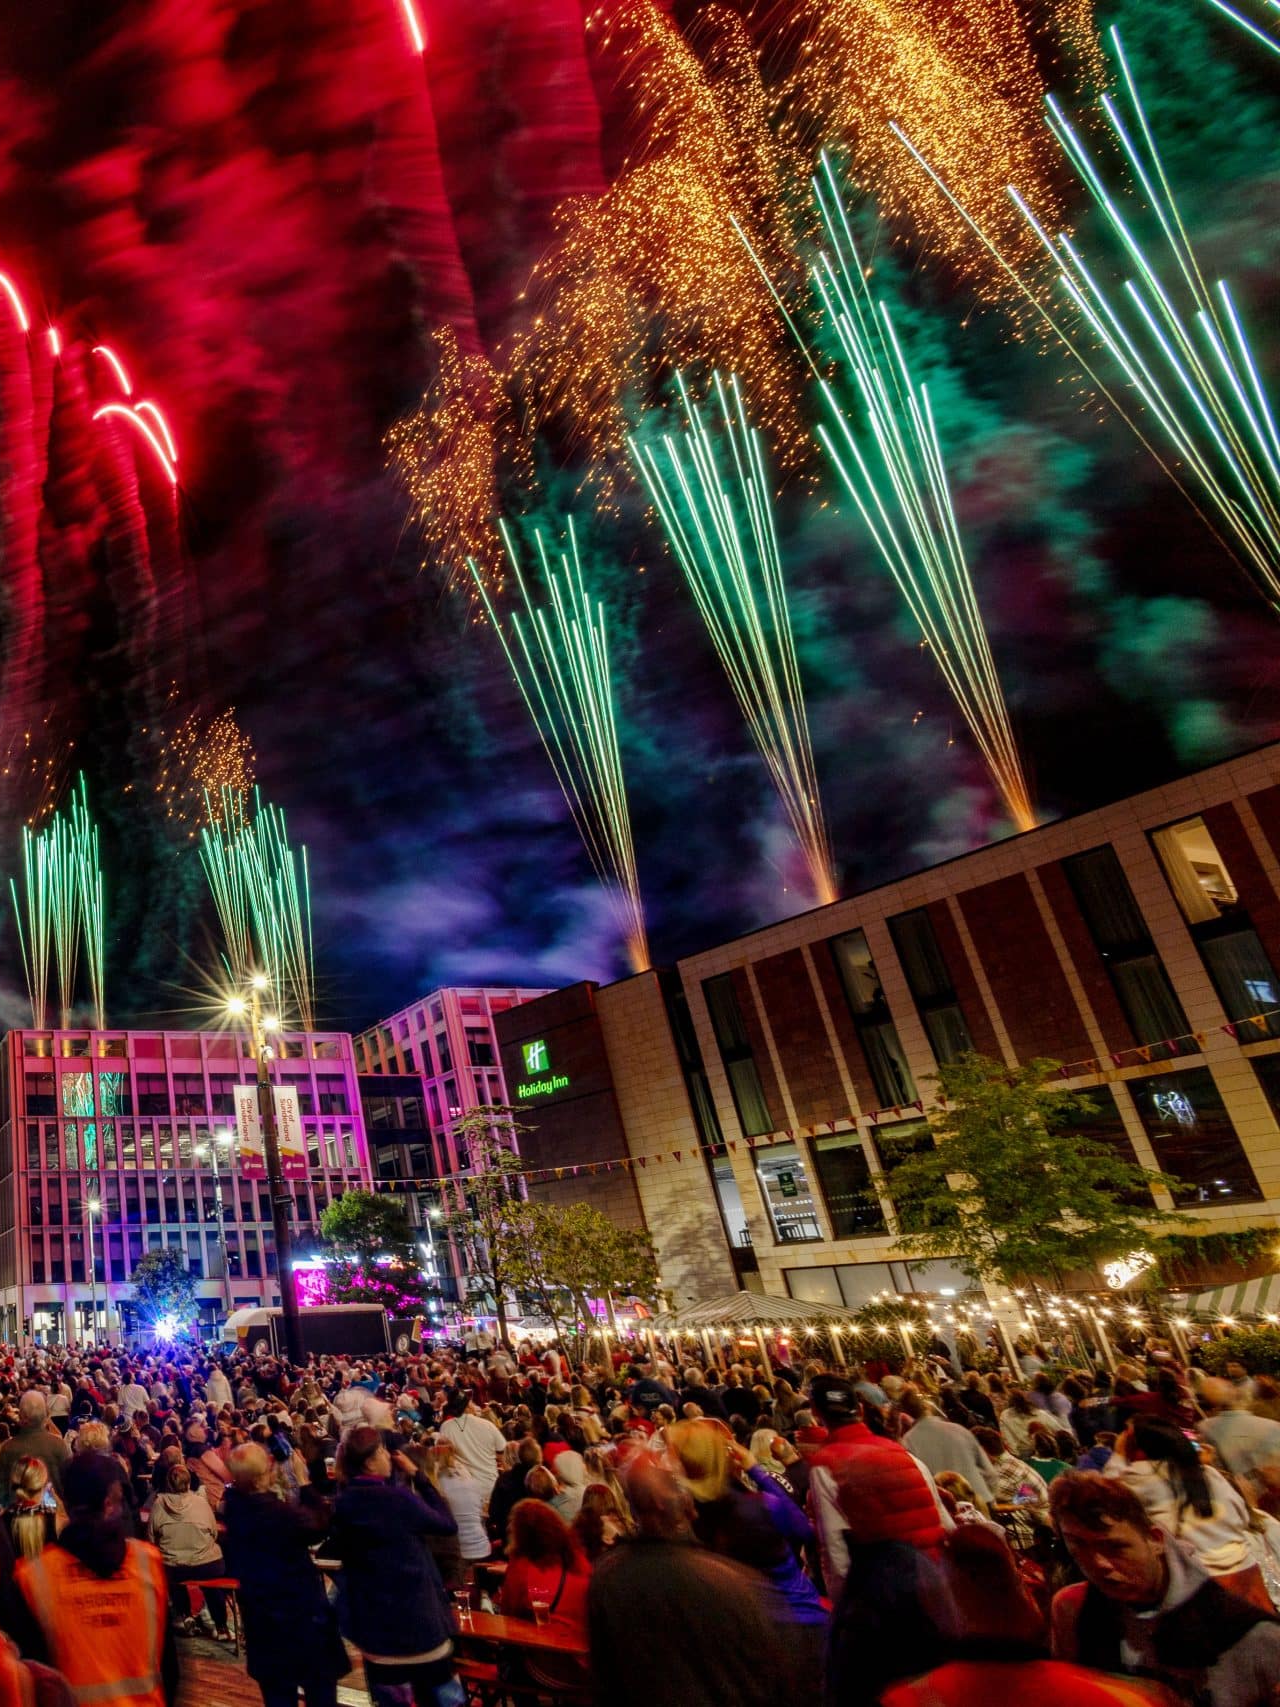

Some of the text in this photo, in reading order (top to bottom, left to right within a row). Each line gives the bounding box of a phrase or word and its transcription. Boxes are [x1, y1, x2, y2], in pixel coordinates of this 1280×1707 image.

[519, 1076, 568, 1098] Holiday Inn
[240, 1098, 250, 1142] Sunderland
[280, 1098, 291, 1142] Sunderland
